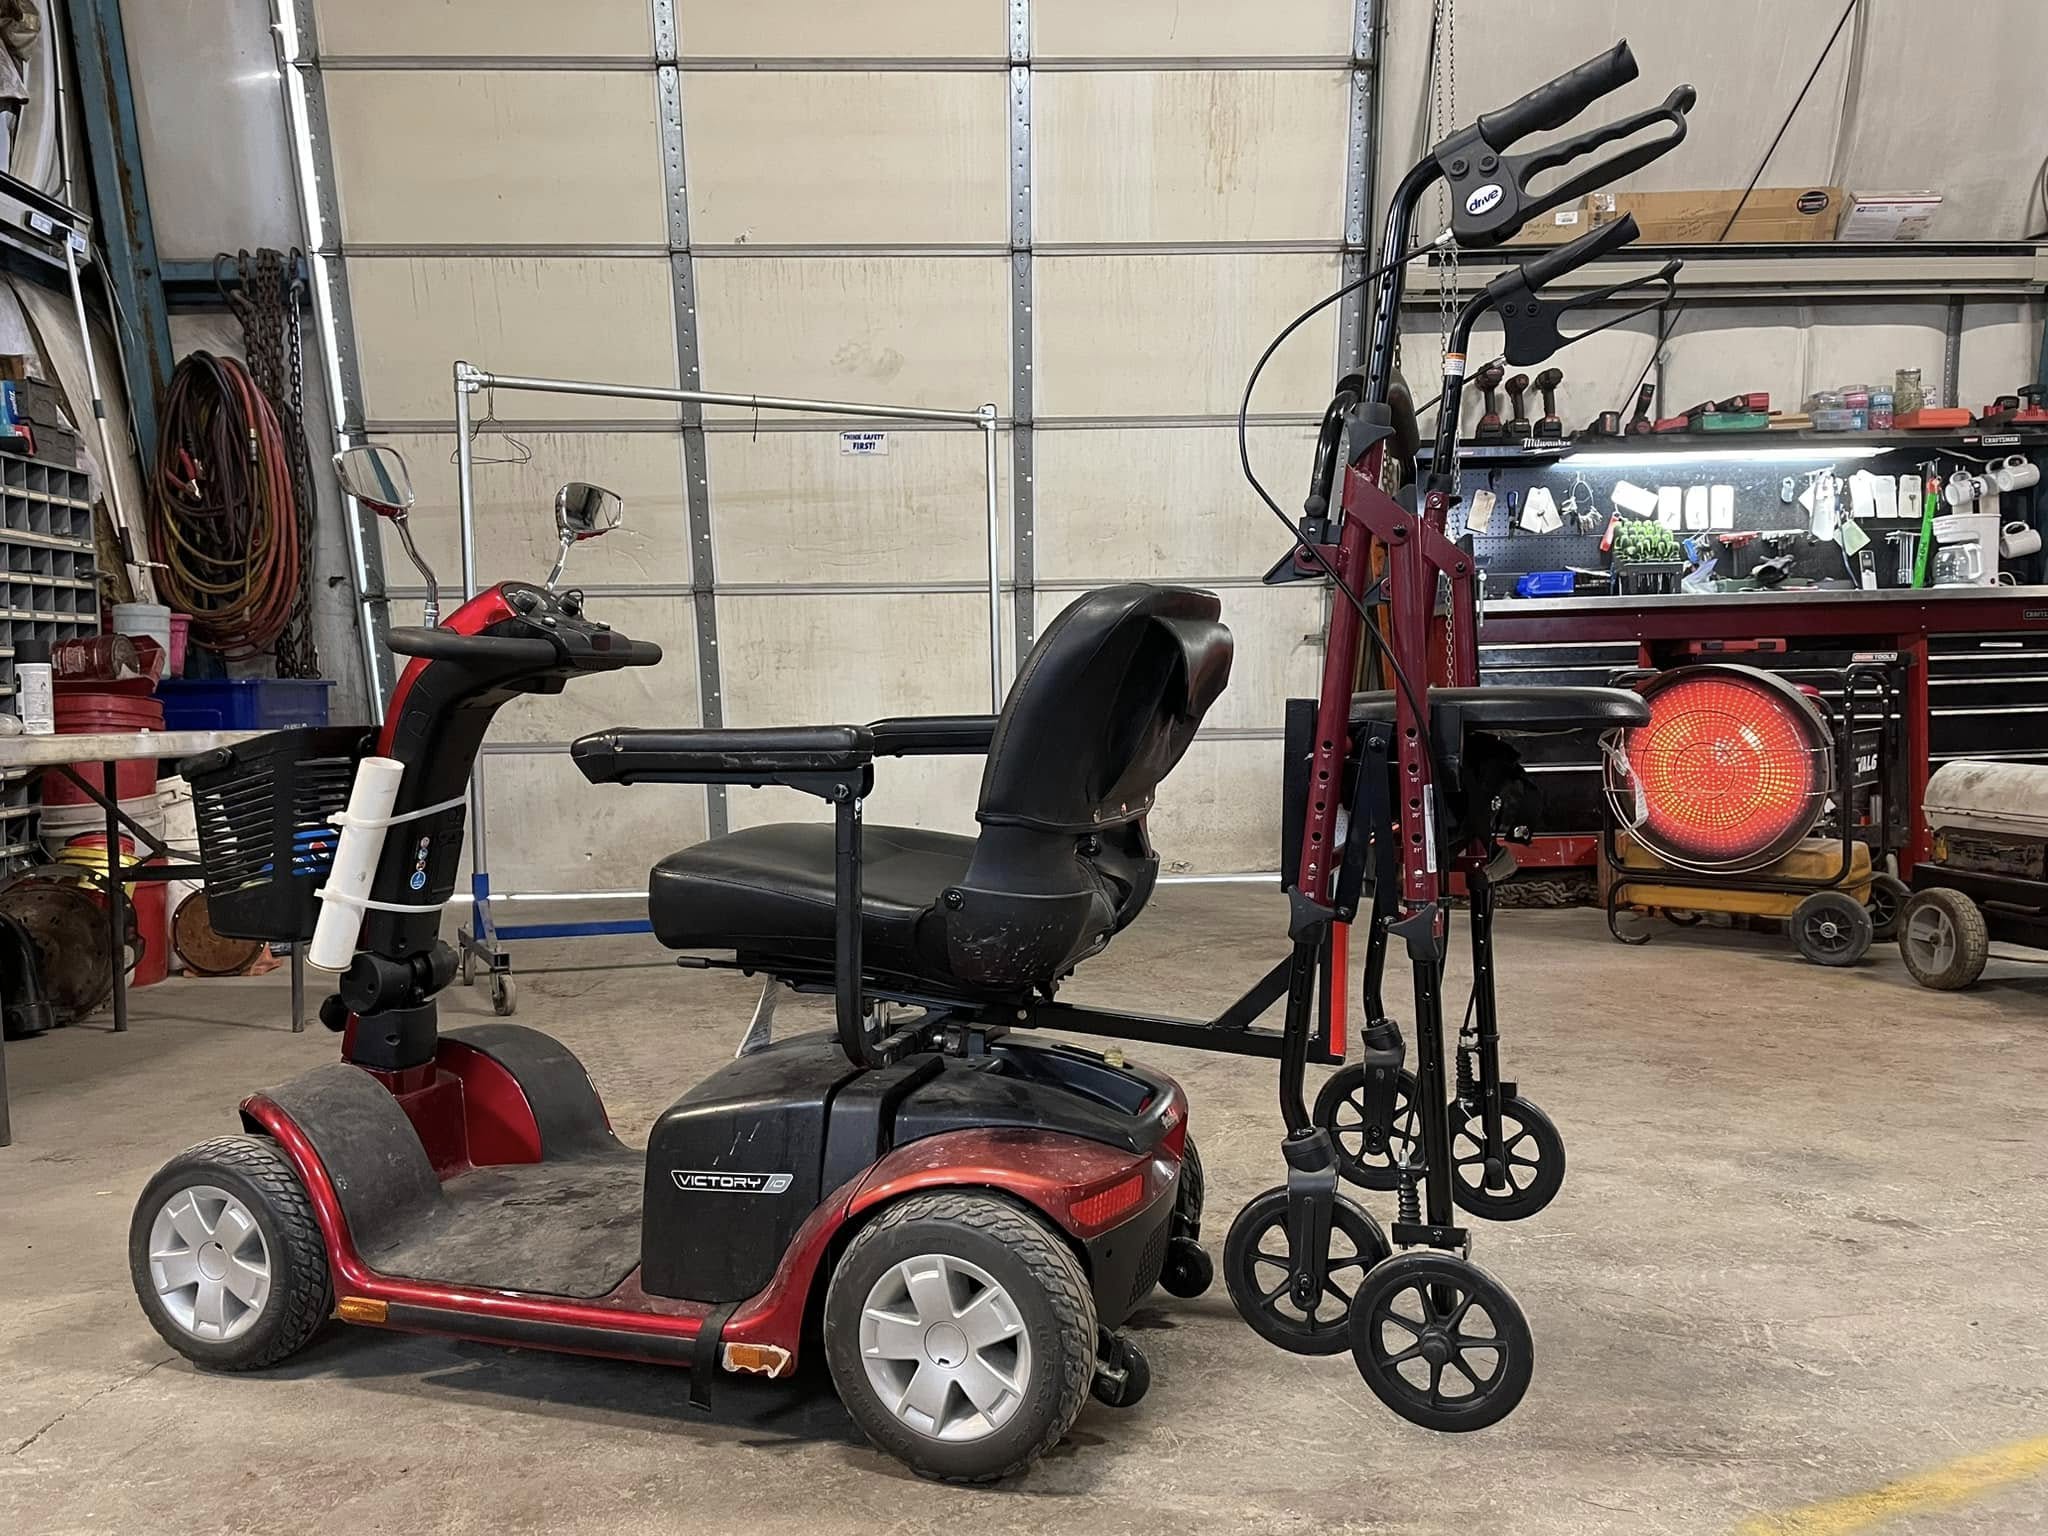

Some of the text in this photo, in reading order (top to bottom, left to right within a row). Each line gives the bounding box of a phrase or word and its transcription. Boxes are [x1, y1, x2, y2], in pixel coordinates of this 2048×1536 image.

[1469, 189, 1499, 212] drive
[852, 442, 876, 450] FIRST!
[1521, 437, 1572, 448] Milwaukee
[678, 1174, 786, 1189] VICTORY 10
